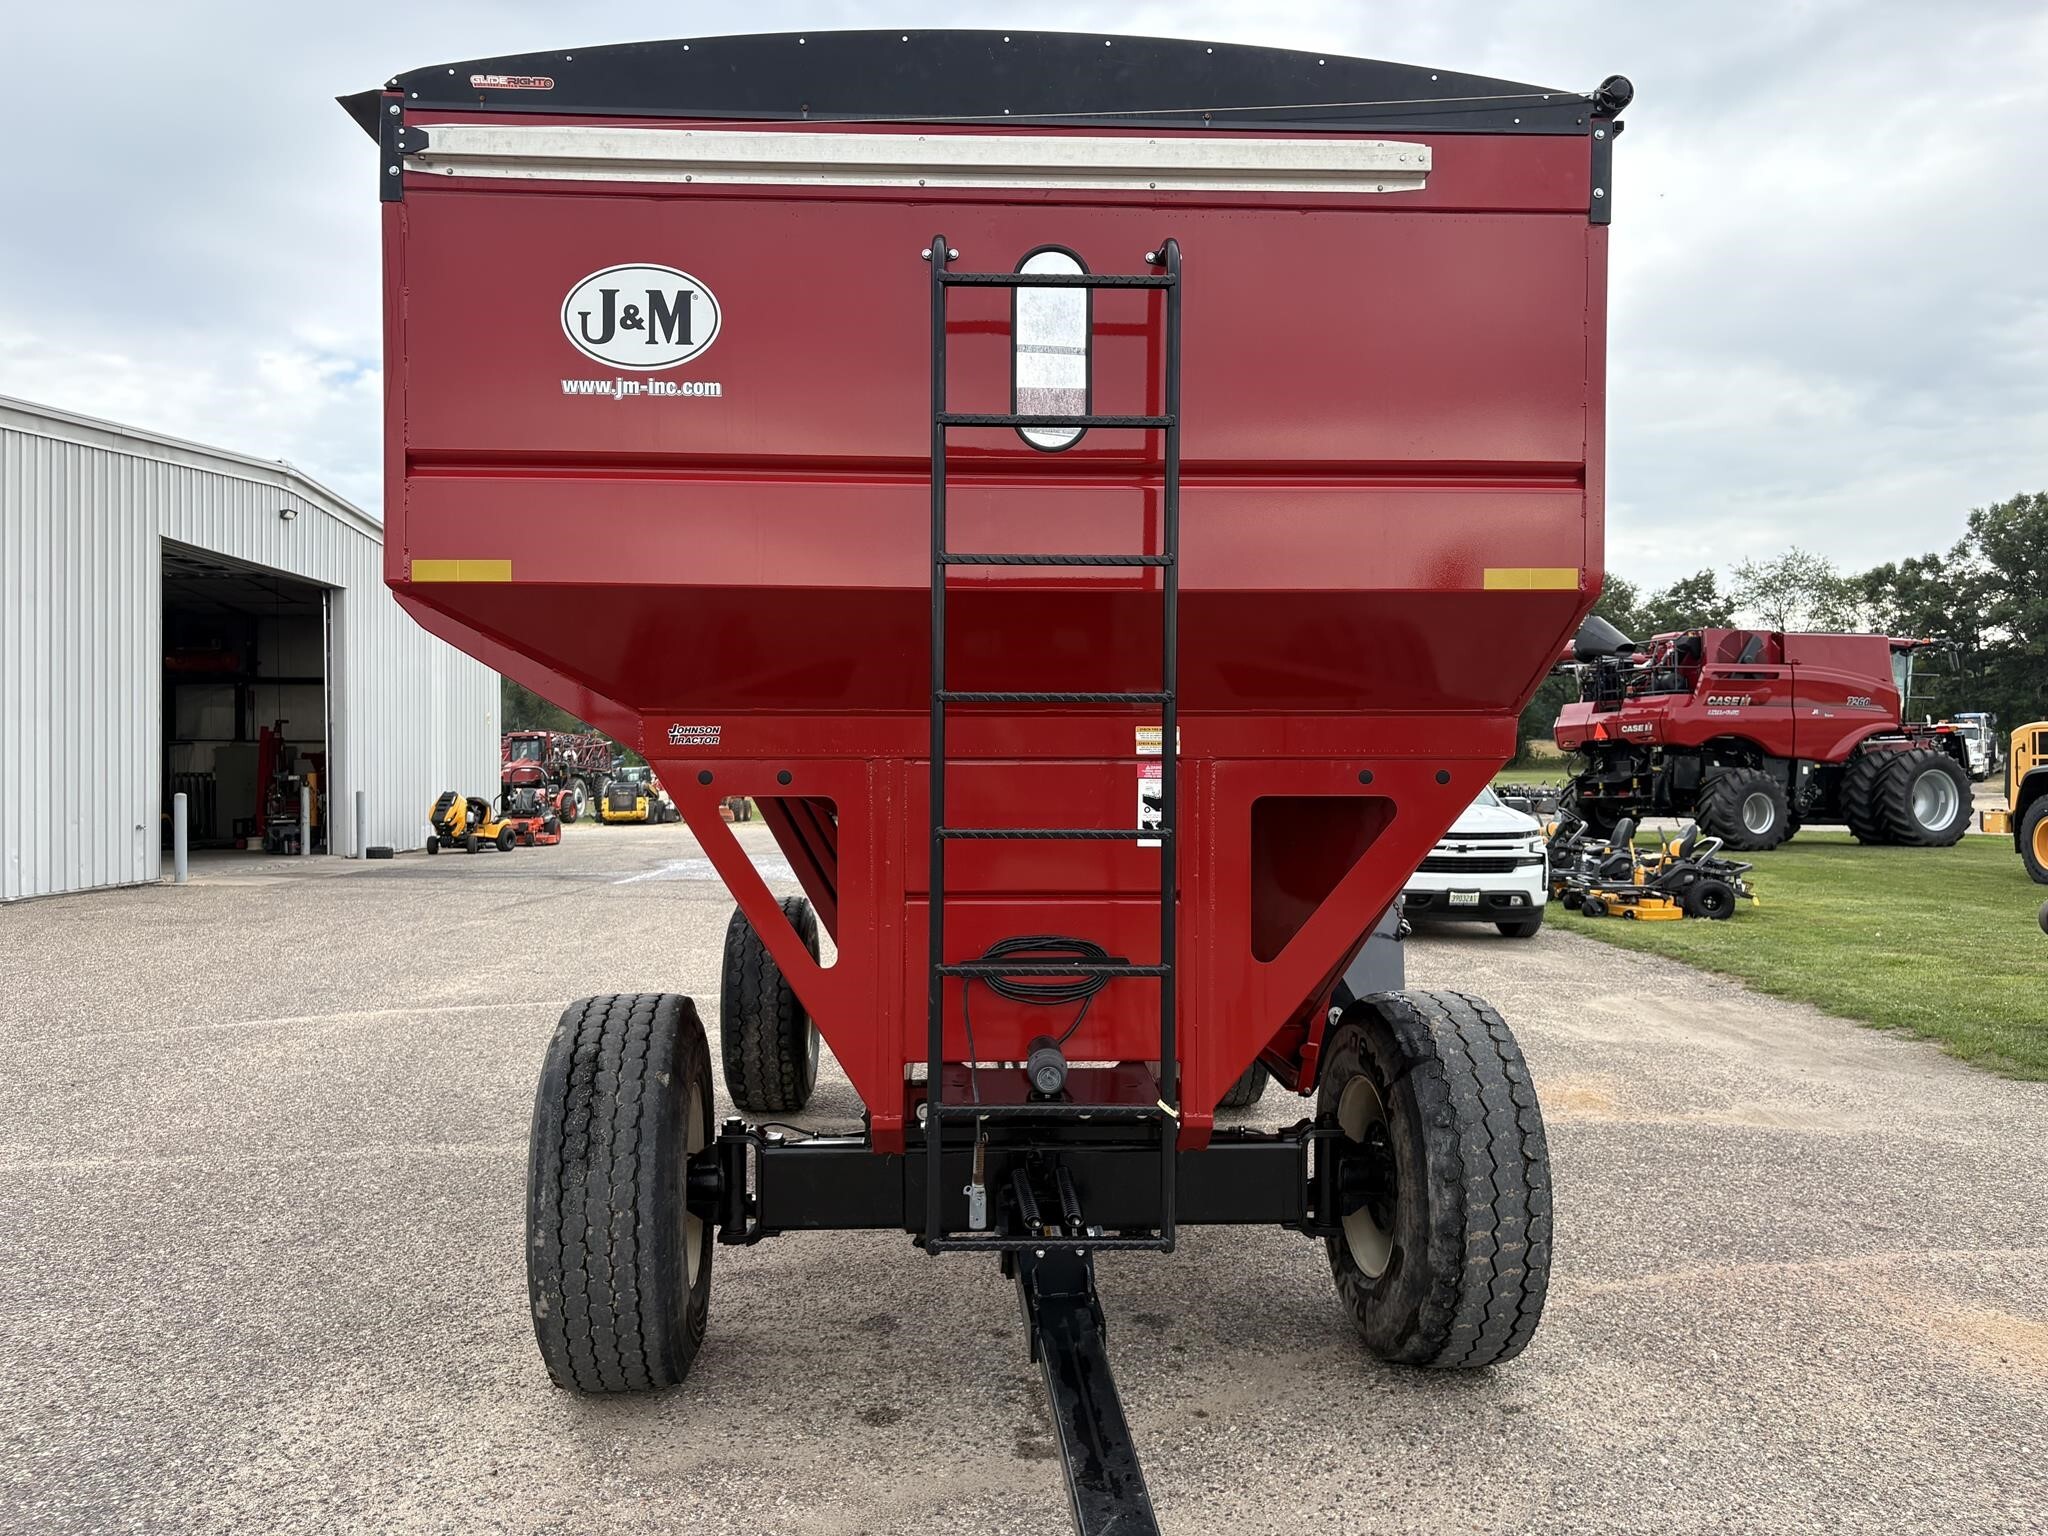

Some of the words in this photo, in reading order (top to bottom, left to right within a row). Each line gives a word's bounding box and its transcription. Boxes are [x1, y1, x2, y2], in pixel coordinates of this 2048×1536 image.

[561, 378, 722, 399] www.jm-inc.com
[1706, 696, 1740, 706] CASE
[668, 723, 721, 734] JOHNSON
[1621, 723, 1644, 733] CASE
[669, 734, 720, 745] TRACTOR
